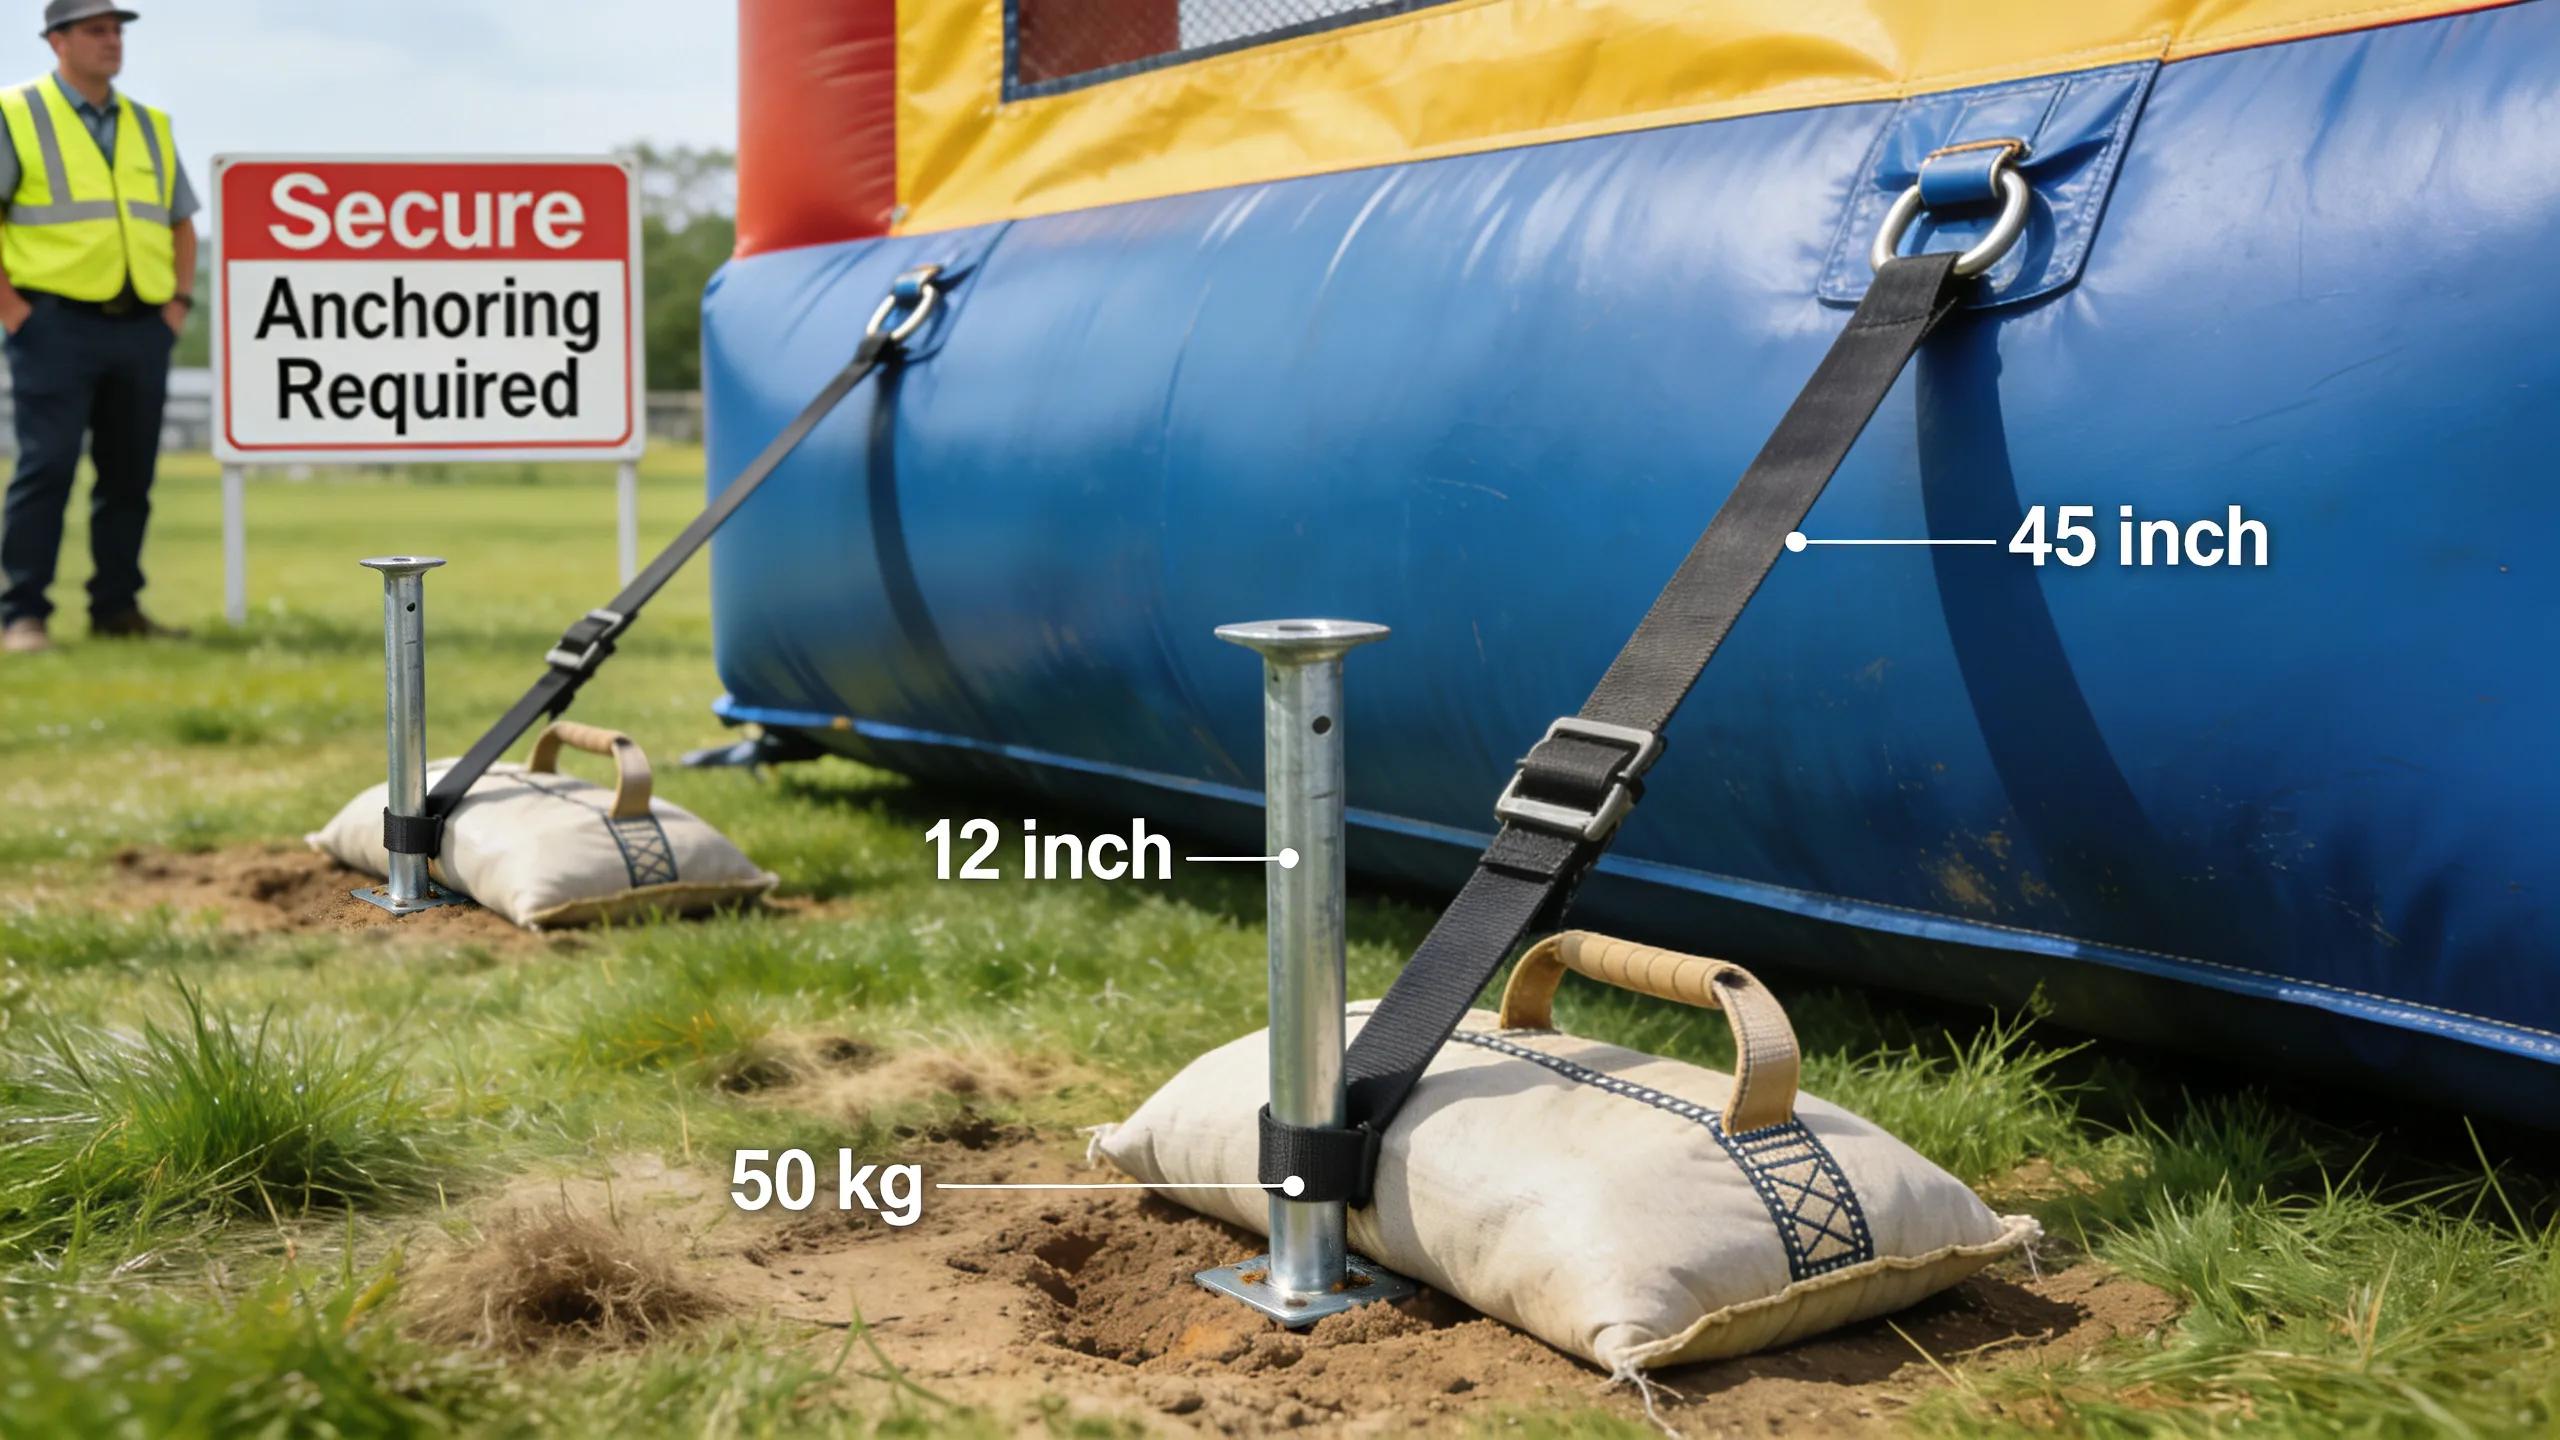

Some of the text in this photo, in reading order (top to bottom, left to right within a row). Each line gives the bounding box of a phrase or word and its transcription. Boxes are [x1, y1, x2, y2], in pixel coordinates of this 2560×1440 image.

[268, 172, 586, 251] Secure
[255, 276, 600, 354] Anchoring
[277, 356, 579, 436] Required
